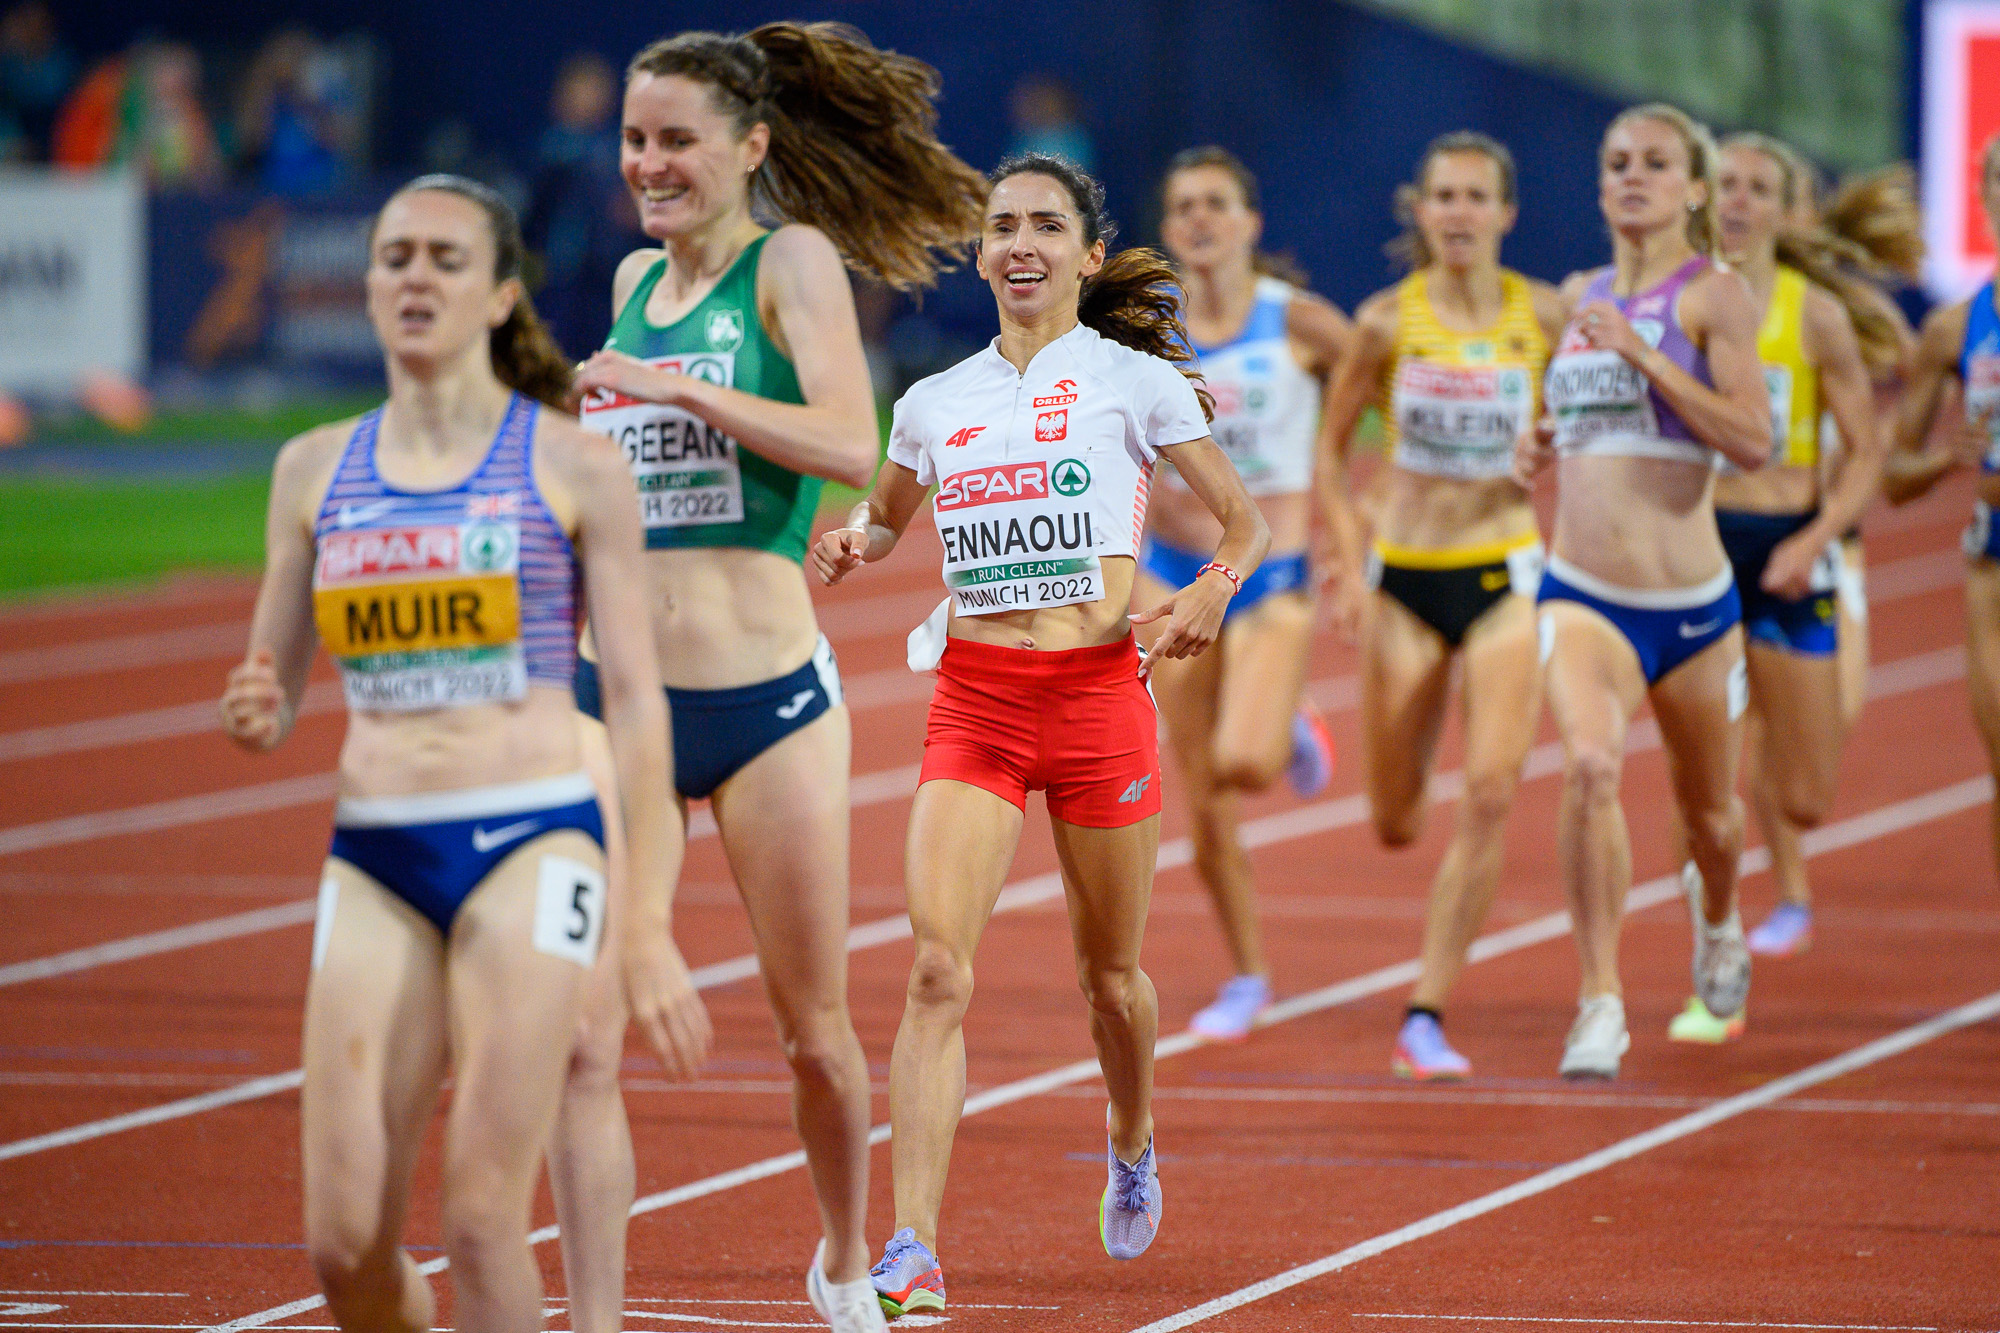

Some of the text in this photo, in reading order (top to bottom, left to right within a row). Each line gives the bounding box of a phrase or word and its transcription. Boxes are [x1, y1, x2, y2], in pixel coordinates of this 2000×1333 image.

[1035, 394, 1077, 407] ORLEN
[1405, 406, 1518, 437] KLEIN
[608, 419, 729, 464] GEEAN
[669, 491, 730, 518] 2022
[939, 466, 1045, 507] SPAR
[941, 511, 1093, 564] ENNAOUI
[957, 576, 1094, 609] MUNICH 2022
[971, 571, 977, 583] I
[978, 567, 1006, 582] RUN
[346, 592, 485, 644] MUIR
[567, 882, 590, 941] 5
